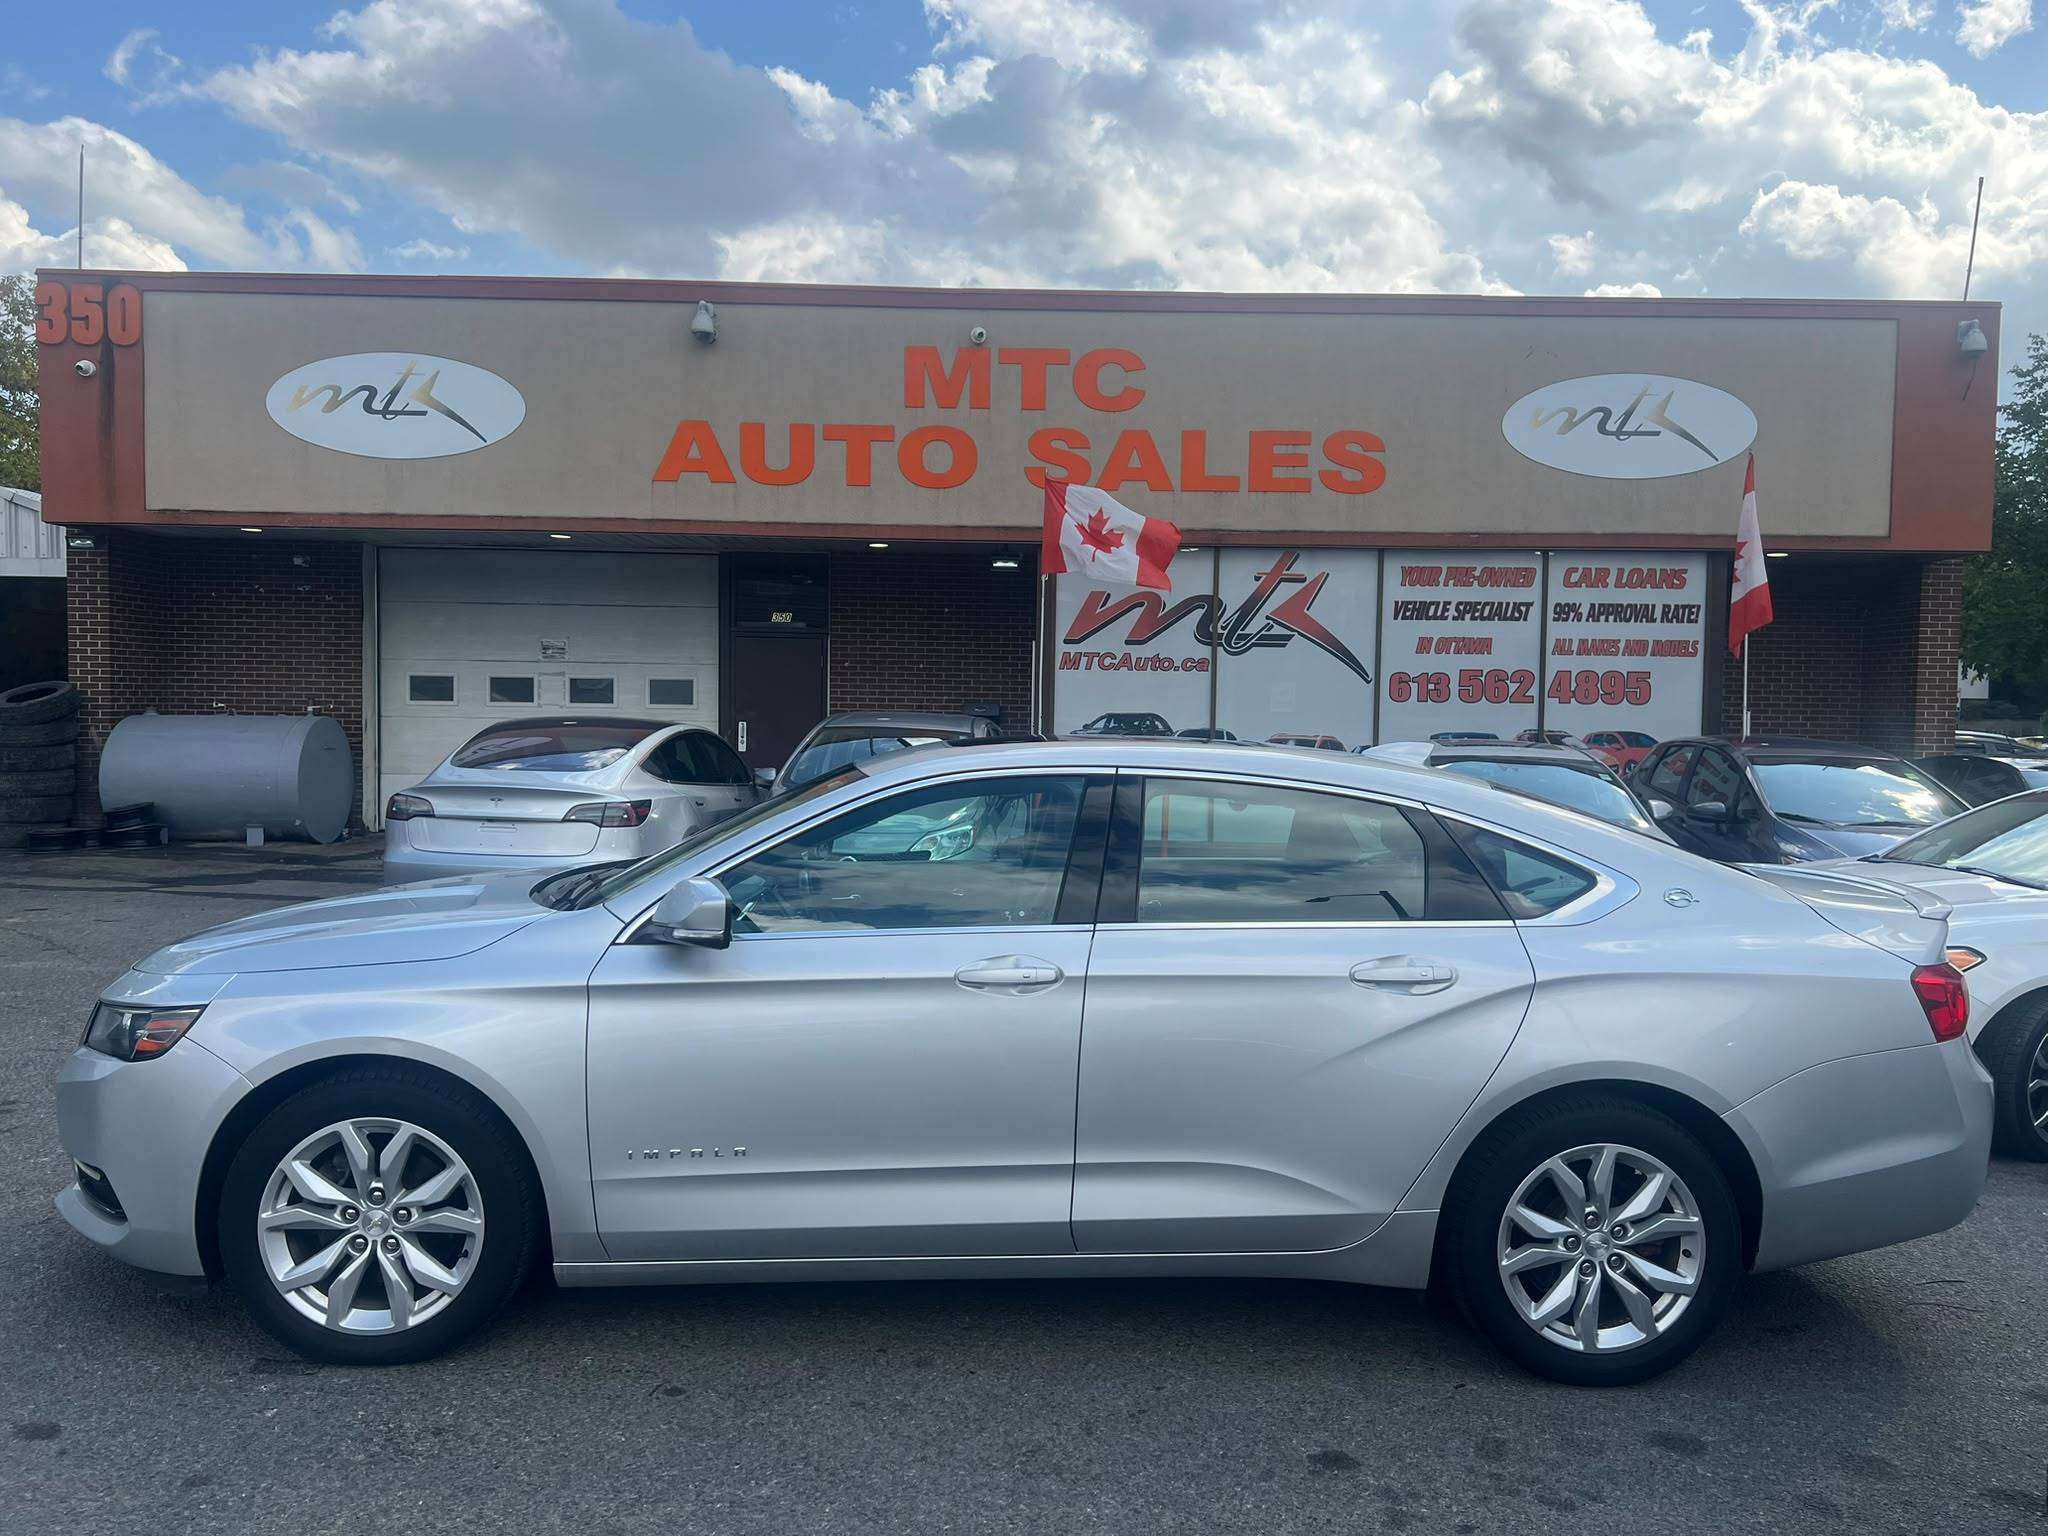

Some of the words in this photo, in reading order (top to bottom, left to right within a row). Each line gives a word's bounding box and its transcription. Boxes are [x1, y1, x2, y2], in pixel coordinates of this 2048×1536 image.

[36, 284, 142, 346] 350
[904, 346, 1146, 412] MTC
[652, 419, 978, 488] AUTO
[1023, 427, 1386, 494] SALES
[1400, 566, 1440, 586] YOUR
[1443, 566, 1536, 587] PRE-OWNED
[1562, 567, 1610, 588] CAR
[1614, 568, 1687, 589] LOANS
[1393, 600, 1450, 620] VEHICLE
[1452, 601, 1534, 621] SPECIALIST
[1552, 602, 1583, 623] 99%
[1586, 603, 1657, 623] APPROVAL
[1659, 604, 1700, 624] RATE!
[1415, 637, 1433, 654] IN
[1435, 637, 1492, 654] OTTAWA
[1552, 638, 1574, 655] ALL
[1576, 639, 1620, 656] MAKES
[1622, 639, 1650, 656] AND
[1651, 640, 1699, 657] MODELS
[1058, 652, 1210, 672] MTCAuto.ca
[1389, 671, 1451, 703] 613
[1458, 669, 1535, 704] 562
[1548, 670, 1652, 705] 4895
[627, 1147, 747, 1160] IMPALA
